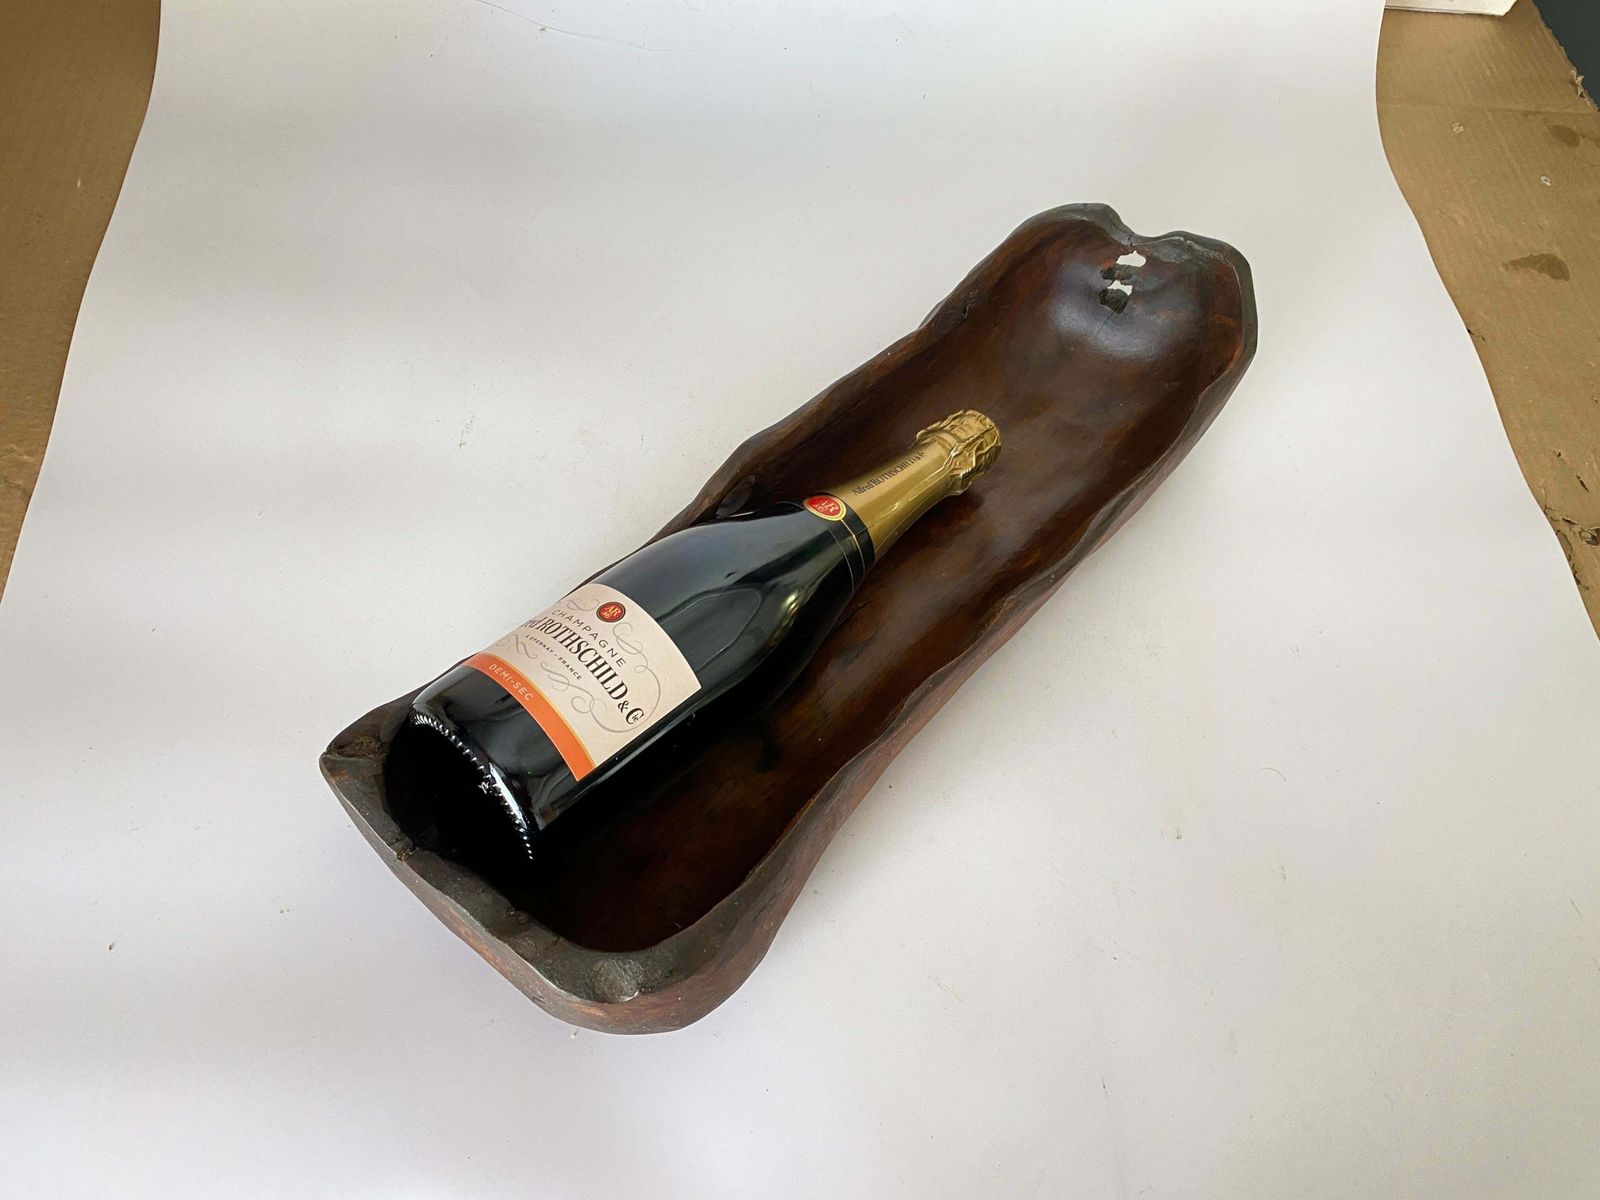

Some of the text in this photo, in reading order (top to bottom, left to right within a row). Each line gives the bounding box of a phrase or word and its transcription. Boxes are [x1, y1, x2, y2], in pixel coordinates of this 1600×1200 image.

[852, 480, 874, 496] Alfred
[551, 608, 627, 667] CHAMPAGNE
[488, 664, 534, 702] DEMI-SEC
[535, 618, 628, 700] ROTHSCHILD
[617, 700, 630, 713] &
[558, 657, 582, 681] FRANCE
